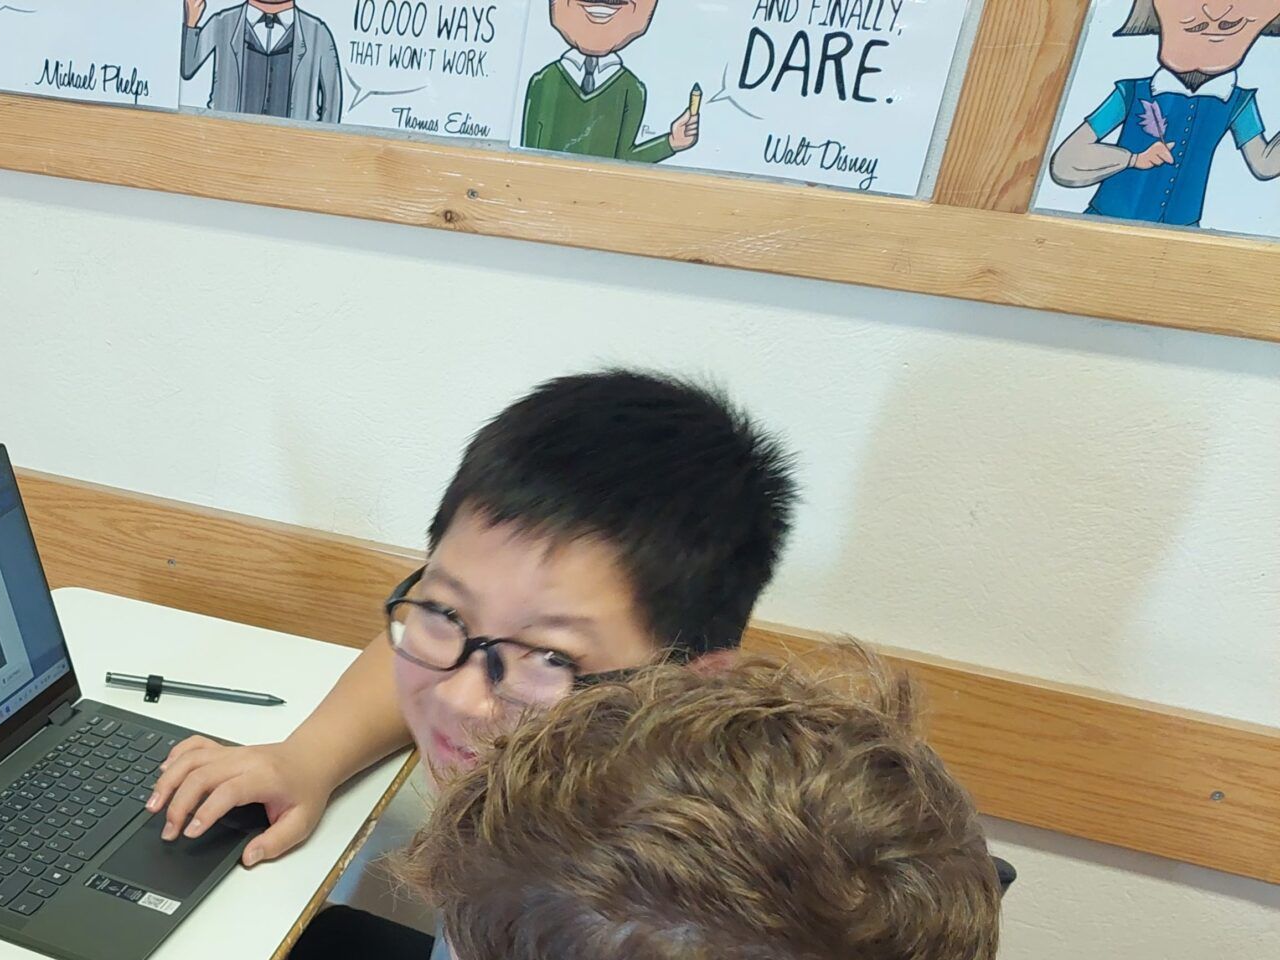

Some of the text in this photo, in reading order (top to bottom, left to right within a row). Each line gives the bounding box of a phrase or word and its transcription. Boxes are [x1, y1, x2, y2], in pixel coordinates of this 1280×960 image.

[353, 0, 497, 43] 10,000 WAYS
[752, 0, 799, 23] AND
[349, 41, 489, 77] THAT WON'T WORK.
[738, 26, 894, 104] DARE.
[34, 58, 149, 105] Michael Phelps
[391, 107, 491, 137] Thomas Edison
[763, 134, 879, 191] Walt Disney
